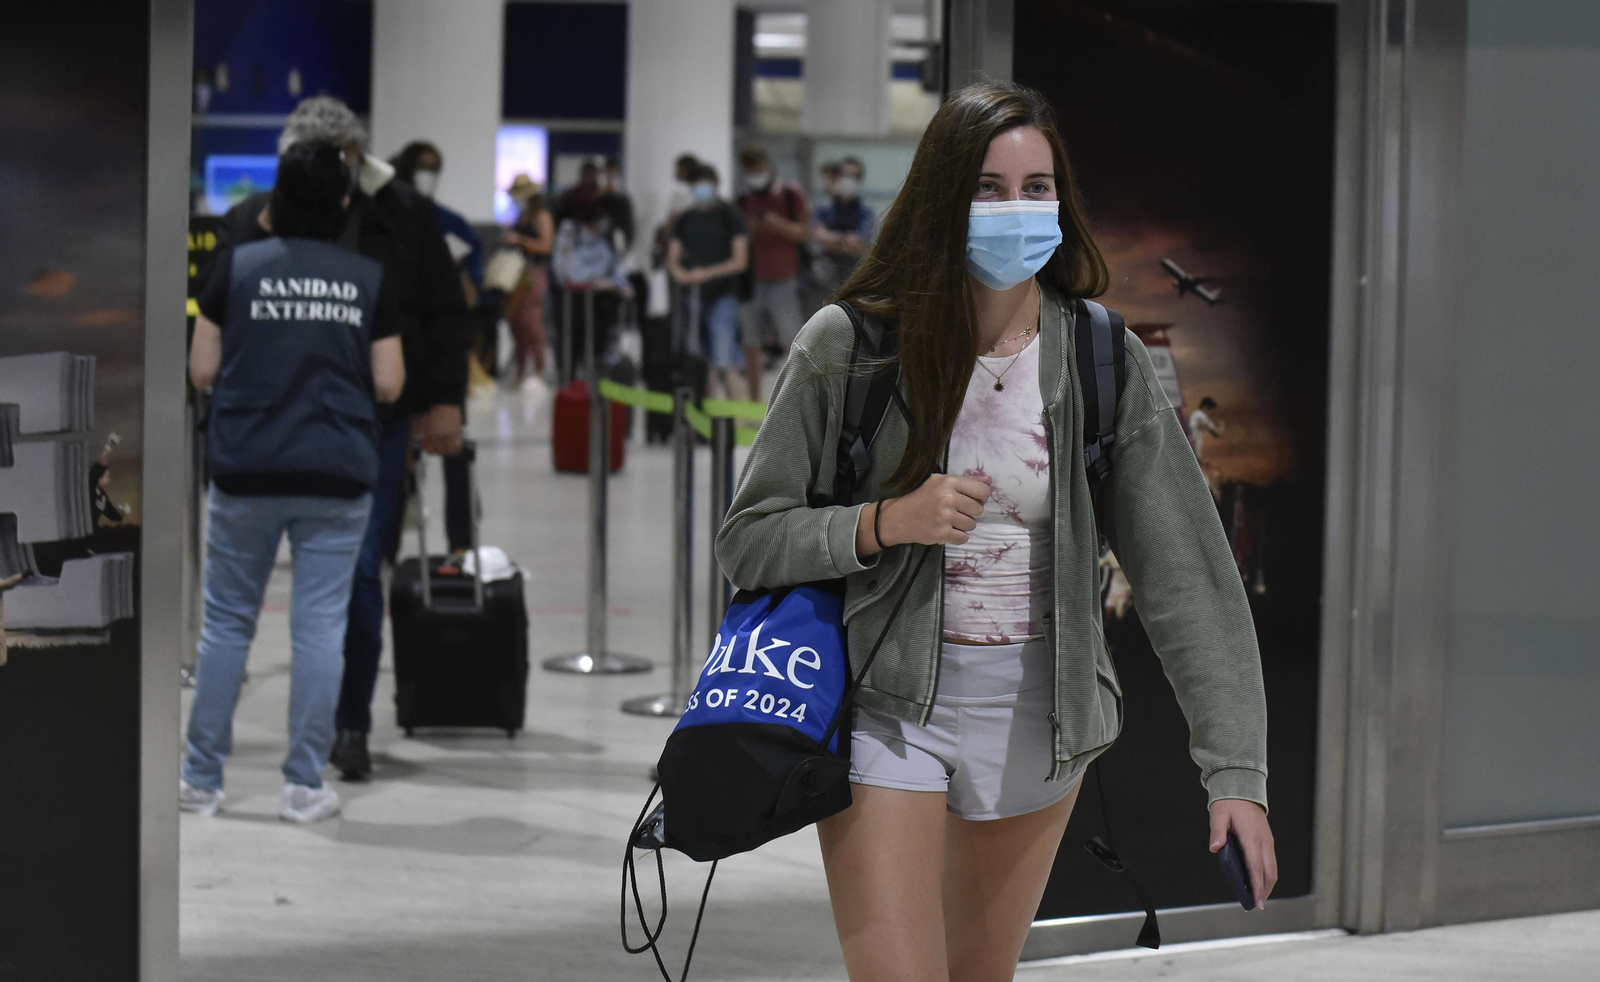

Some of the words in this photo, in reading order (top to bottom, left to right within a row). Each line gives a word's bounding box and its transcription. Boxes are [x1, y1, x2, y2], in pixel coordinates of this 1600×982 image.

[259, 277, 358, 301] SANIDAD
[250, 300, 362, 328] EXTERIOR
[705, 688, 739, 708] OF
[743, 688, 807, 723] 2024
